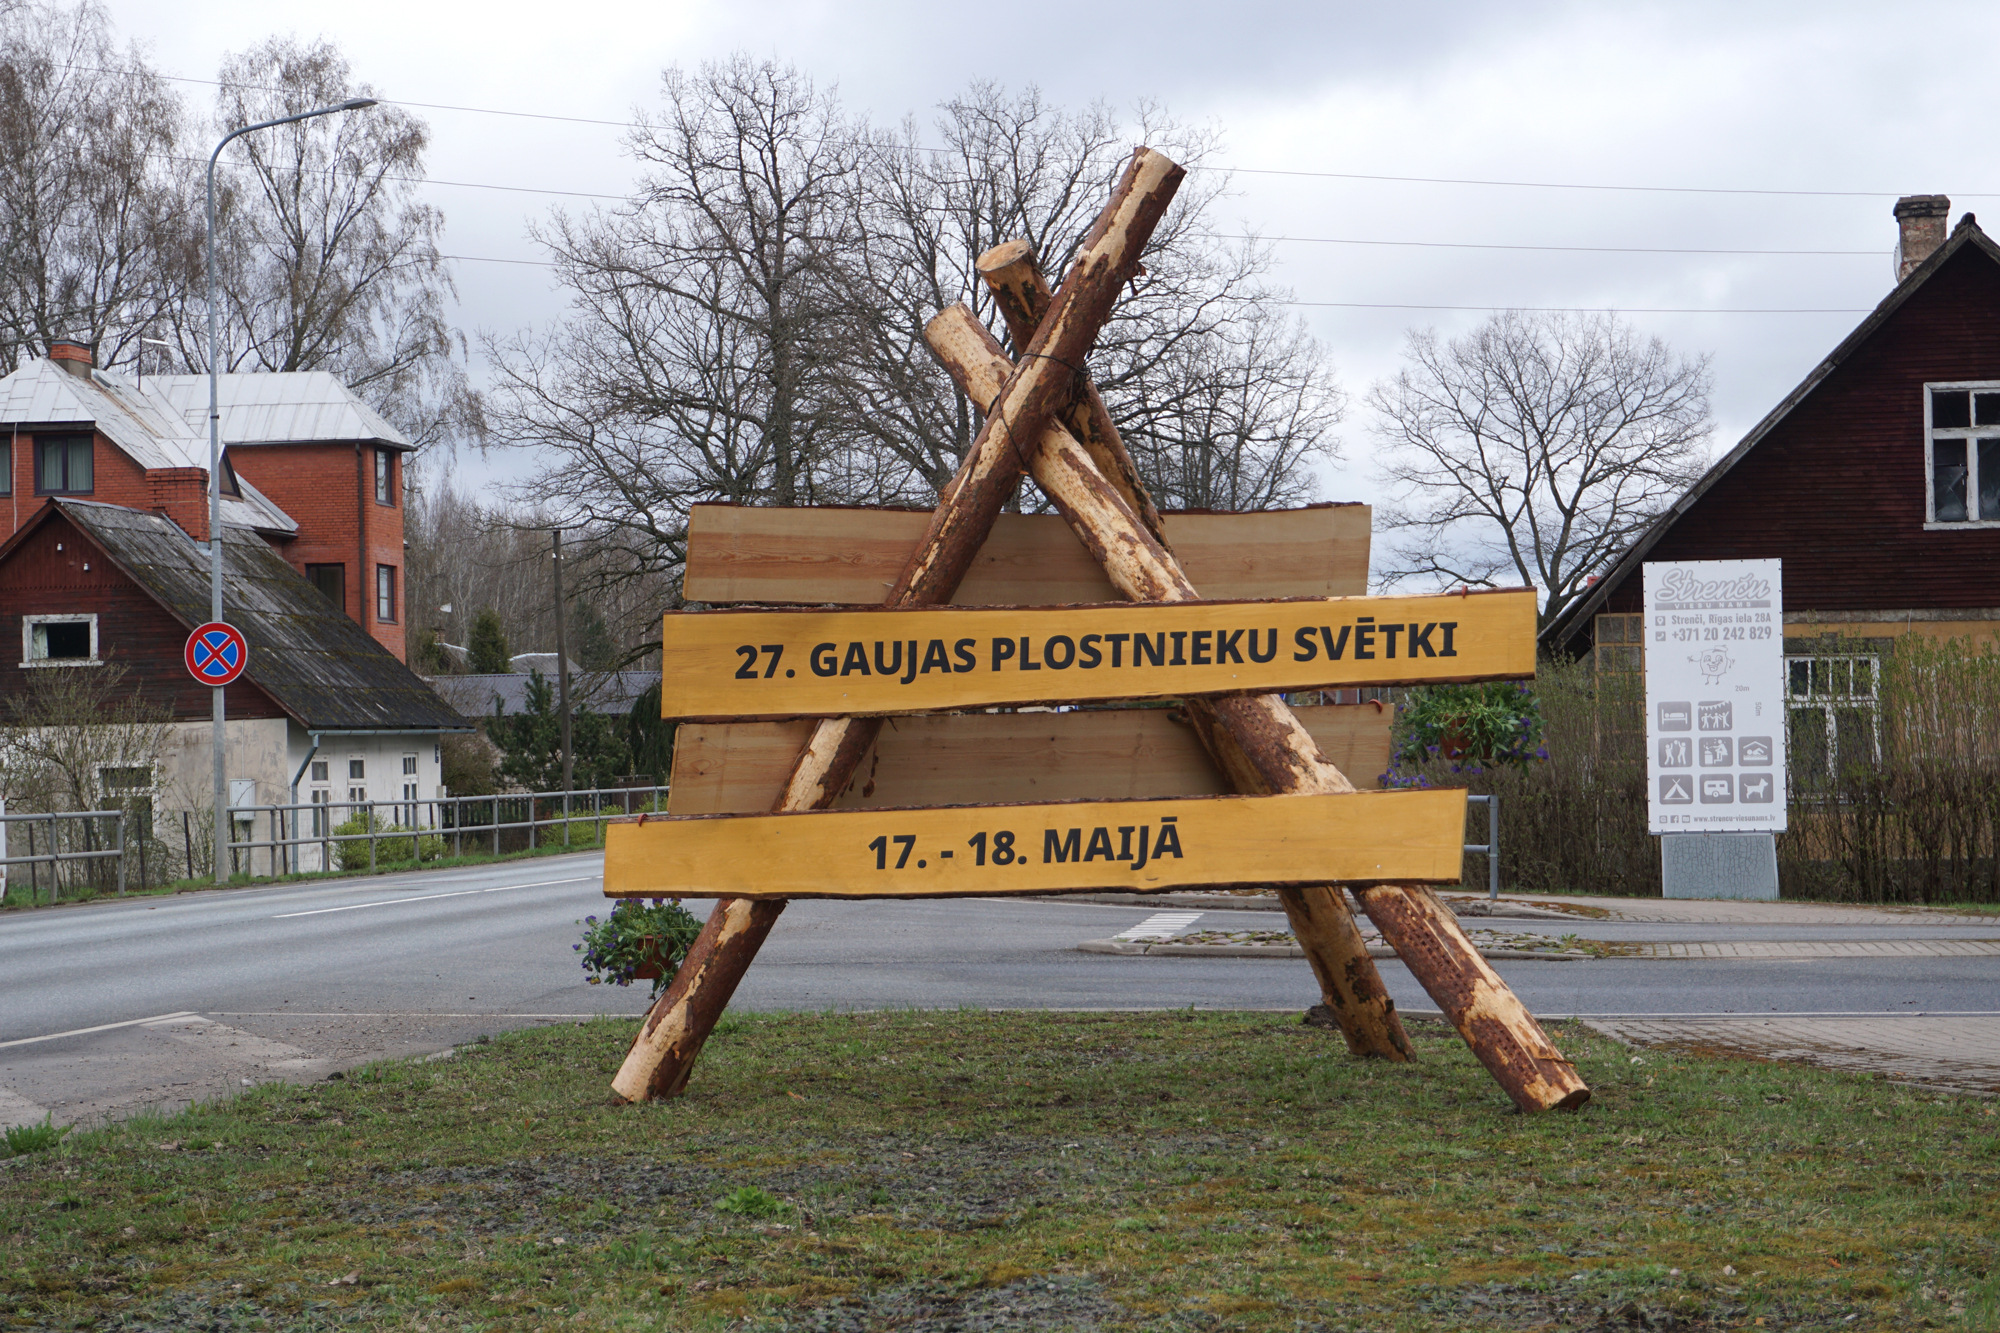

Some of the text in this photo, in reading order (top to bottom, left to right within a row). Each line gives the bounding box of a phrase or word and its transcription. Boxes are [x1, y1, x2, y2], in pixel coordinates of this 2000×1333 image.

[1655, 568, 1771, 601] Strenču
[1671, 613, 1772, 625] Strenči, Rīgas iela 28A
[1671, 626, 1772, 641] +371 20 242 829
[735, 617, 1457, 684] 27. GAUJAS PLOSTNIEKU SVĒTKI
[869, 835, 926, 869] 17.
[968, 831, 1027, 865] 18.
[1044, 817, 1183, 870] MAIJĀ
